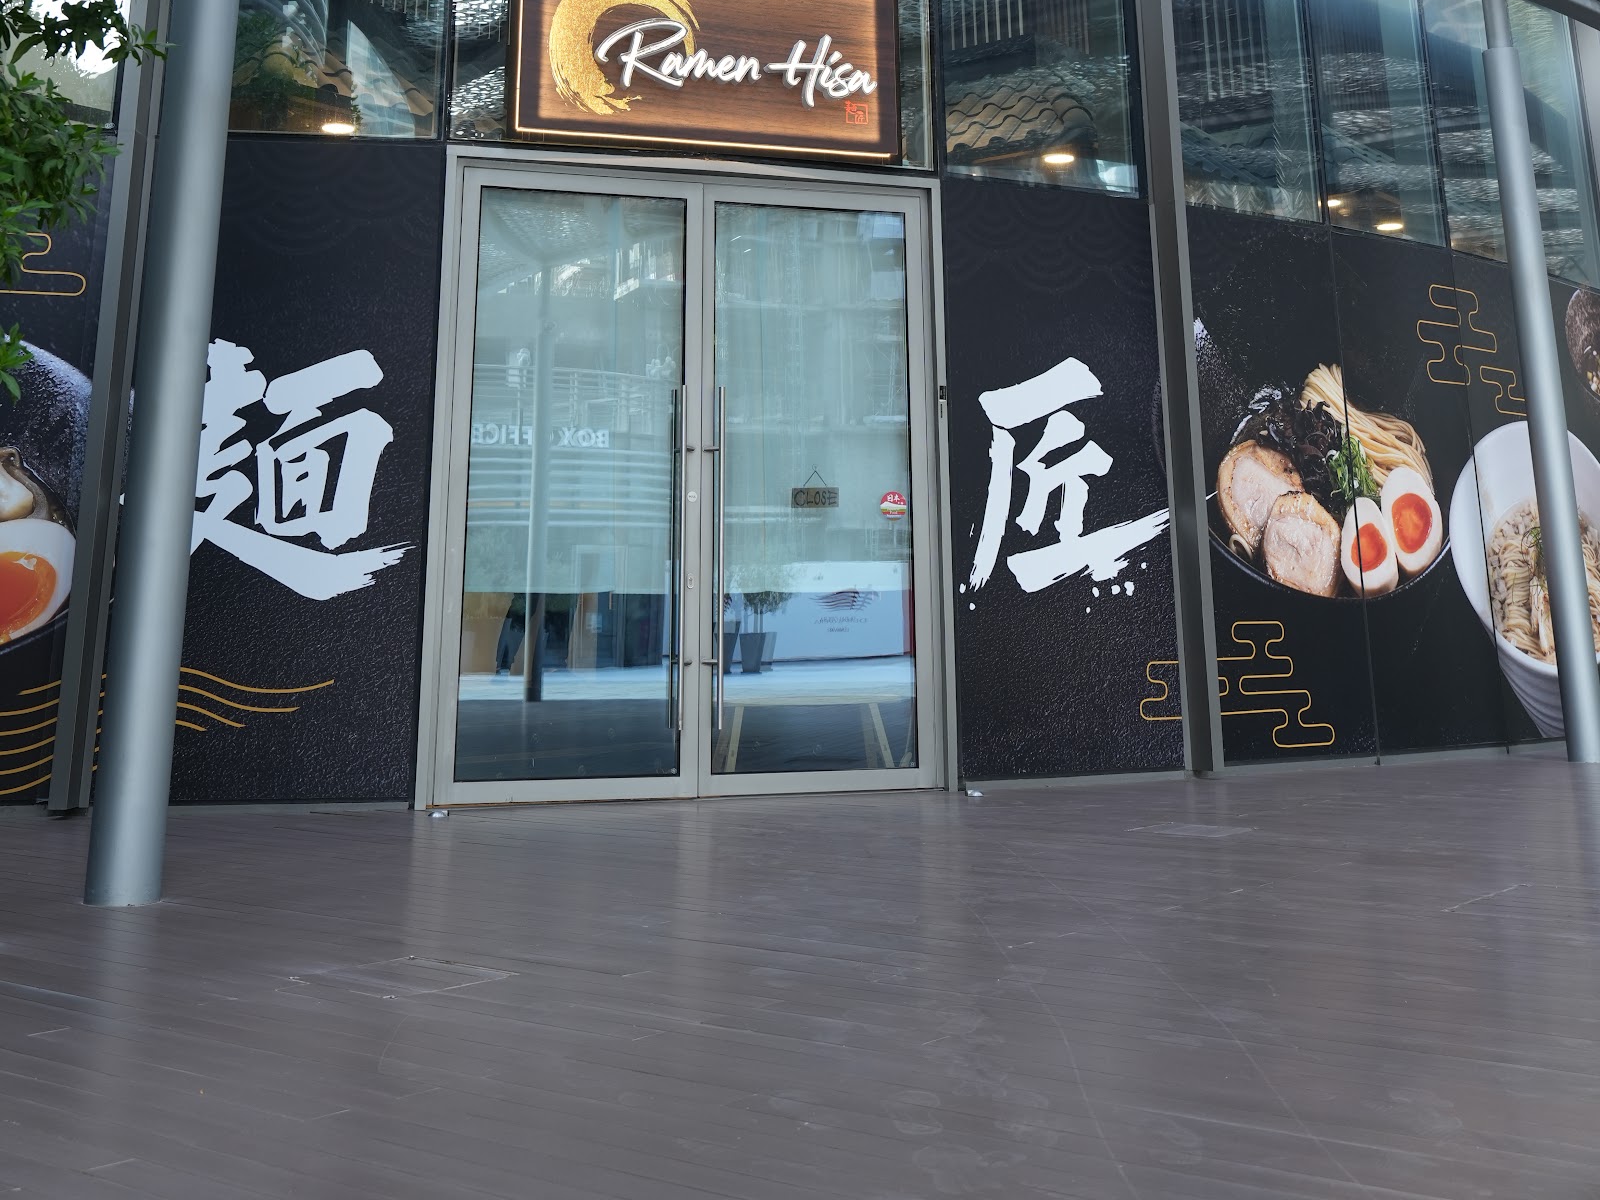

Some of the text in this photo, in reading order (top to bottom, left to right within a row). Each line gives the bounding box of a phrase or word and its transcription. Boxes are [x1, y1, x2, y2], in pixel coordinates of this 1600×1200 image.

[595, 17, 878, 108] Ramen Hisa
[794, 490, 837, 506] CLOSE
[887, 494, 900, 502] 日本
[968, 357, 1170, 594] 匠
